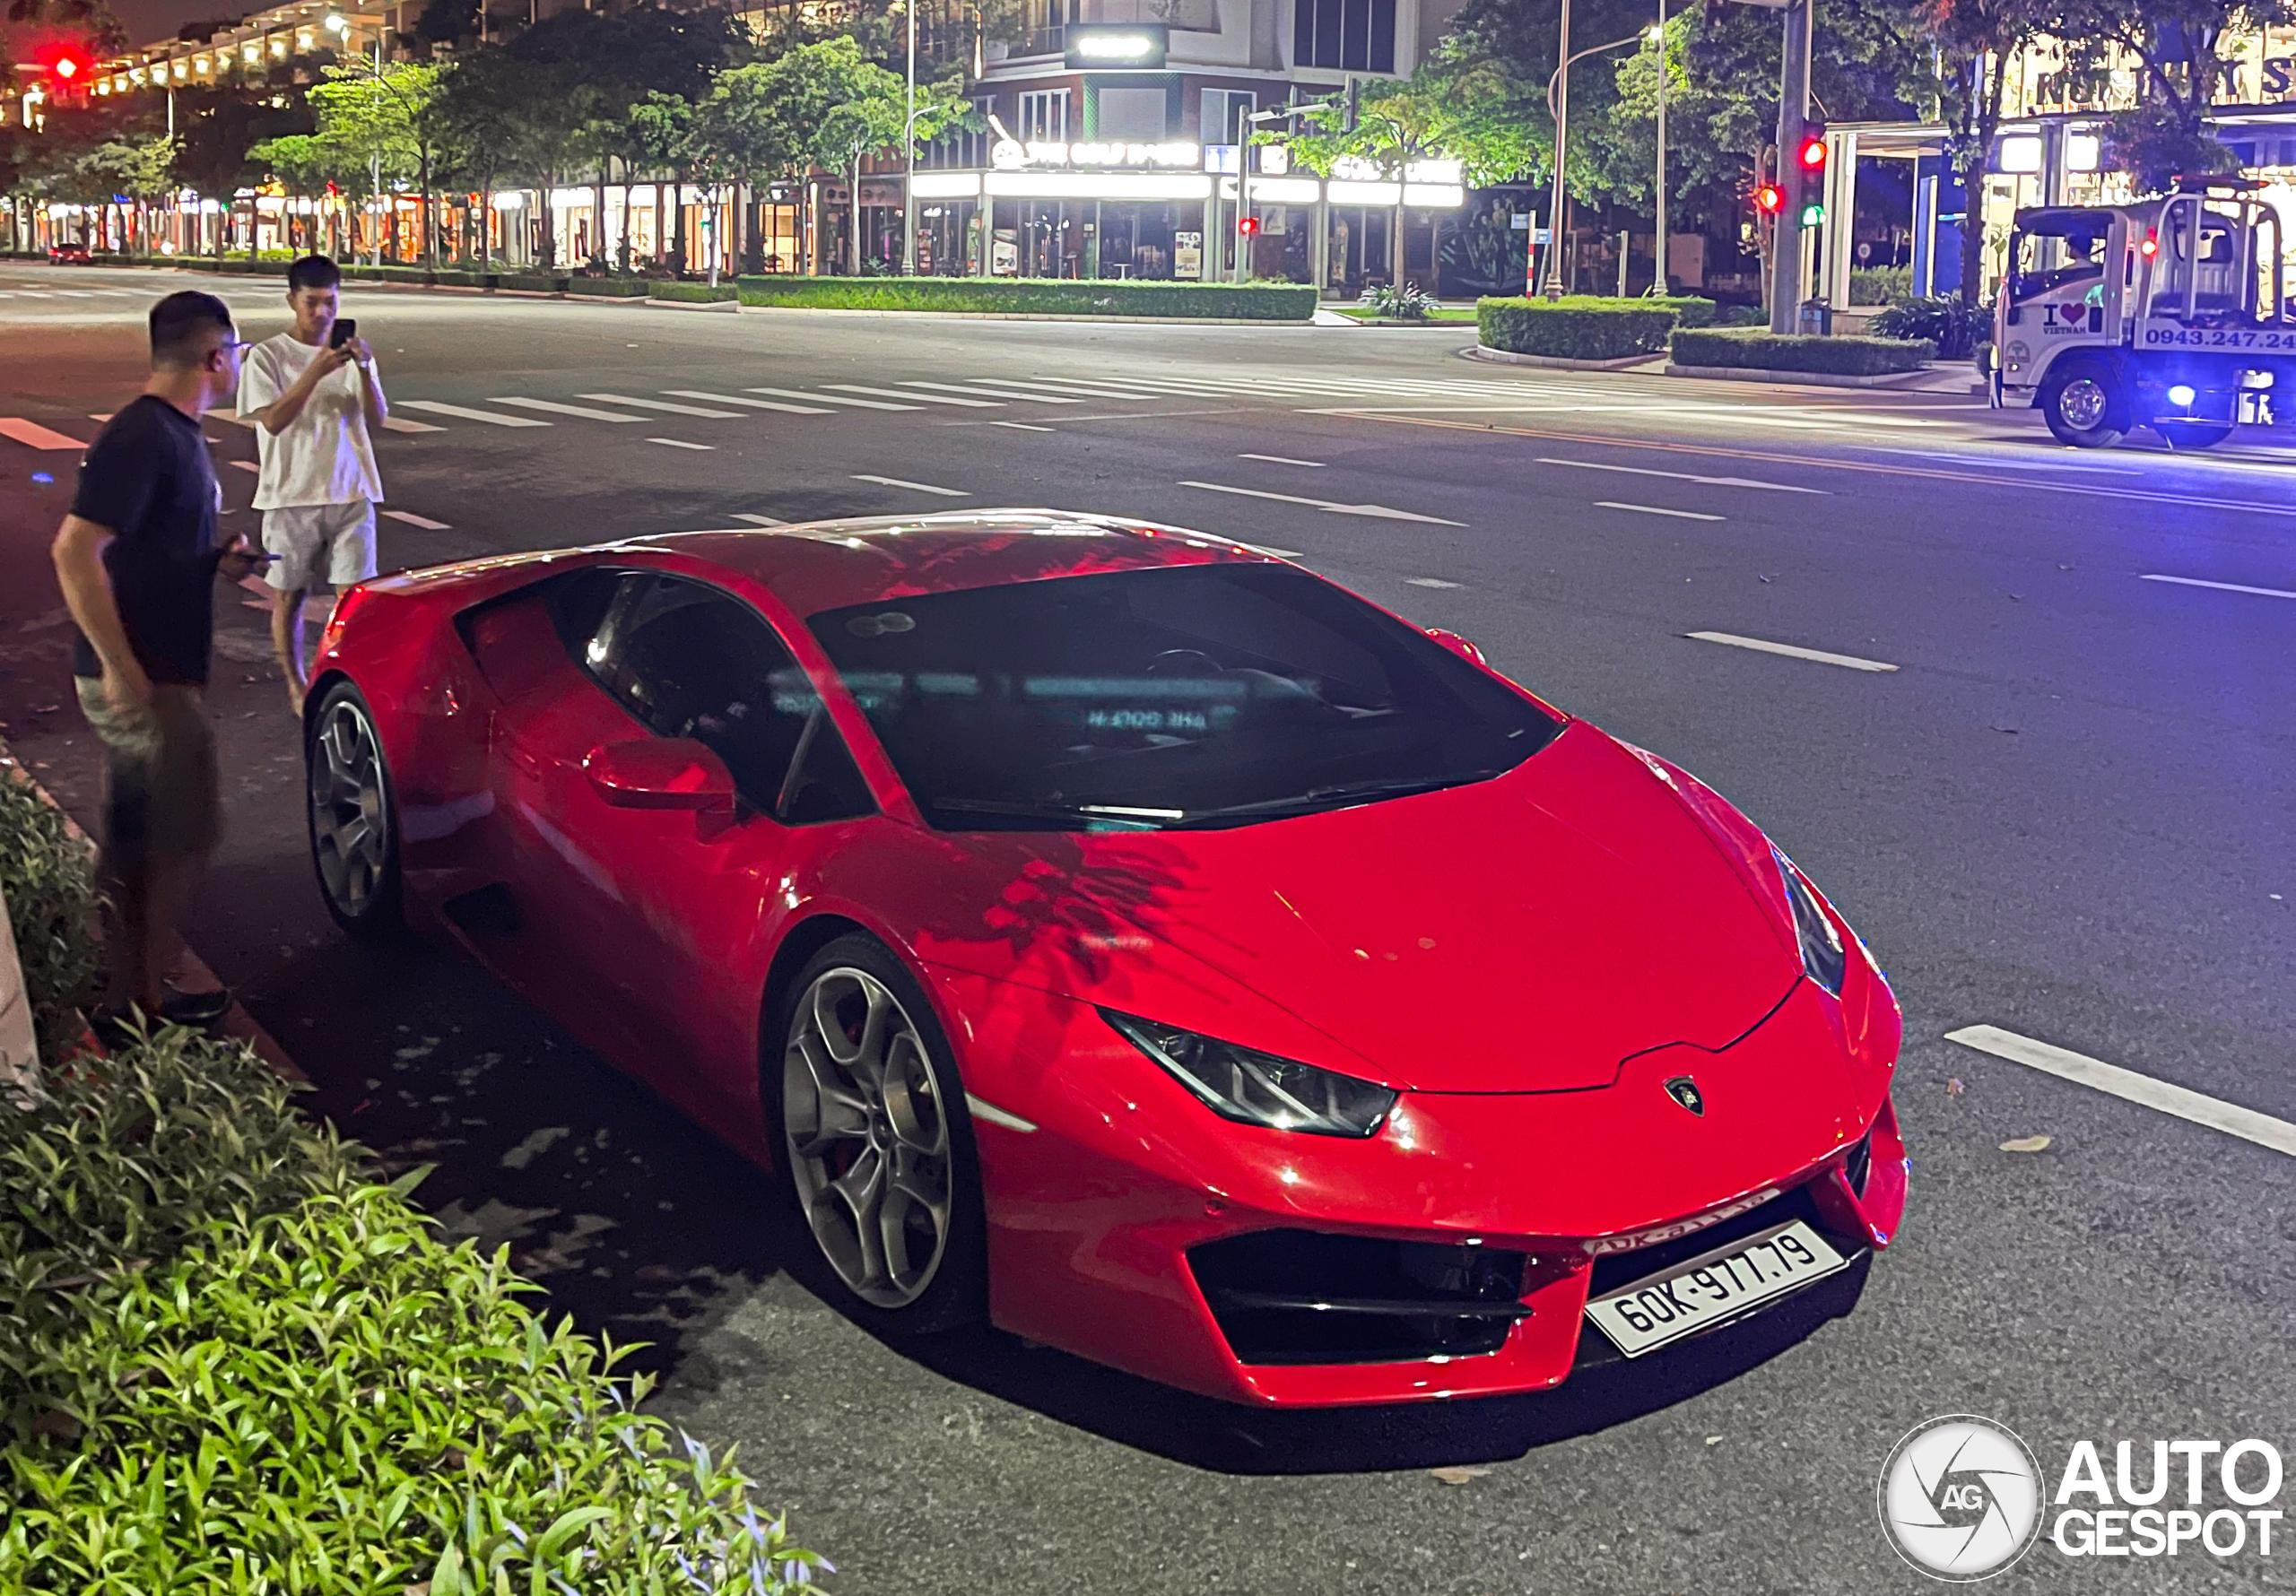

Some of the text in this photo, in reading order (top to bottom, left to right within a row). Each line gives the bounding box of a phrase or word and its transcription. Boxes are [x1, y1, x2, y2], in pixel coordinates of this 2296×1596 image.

[2043, 304, 2058, 326] I
[2043, 326, 2086, 334] VIETNAM
[1614, 1235, 1815, 1332] 60K-977.79
